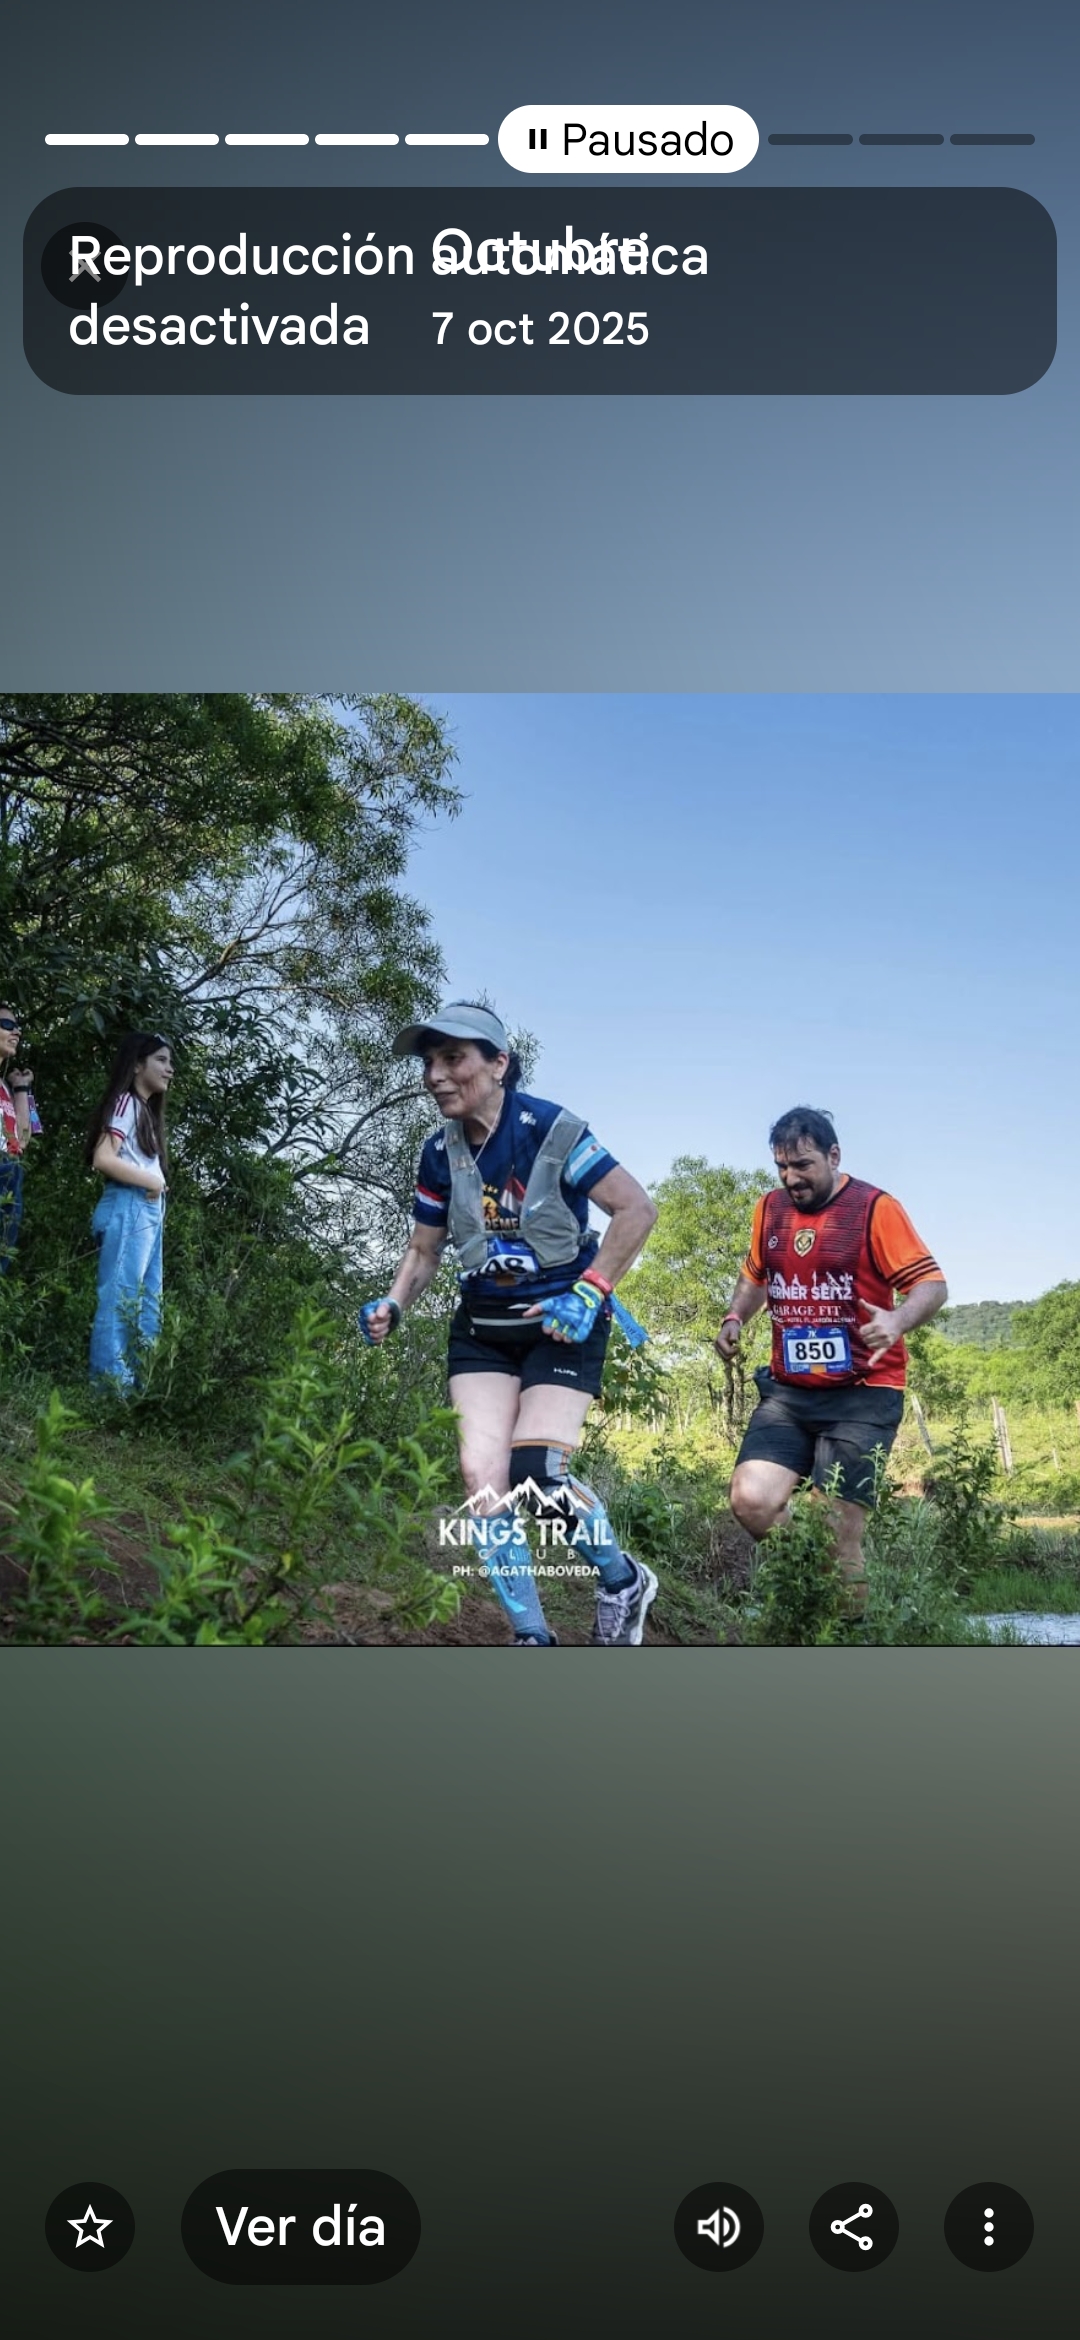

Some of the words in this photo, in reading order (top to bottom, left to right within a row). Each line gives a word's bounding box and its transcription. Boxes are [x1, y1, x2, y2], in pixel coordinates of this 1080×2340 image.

[811, 1284, 853, 1300] SEITZ
[773, 1304, 815, 1316] GARAGE
[819, 1305, 841, 1316] FIT
[795, 1341, 836, 1360] 850
